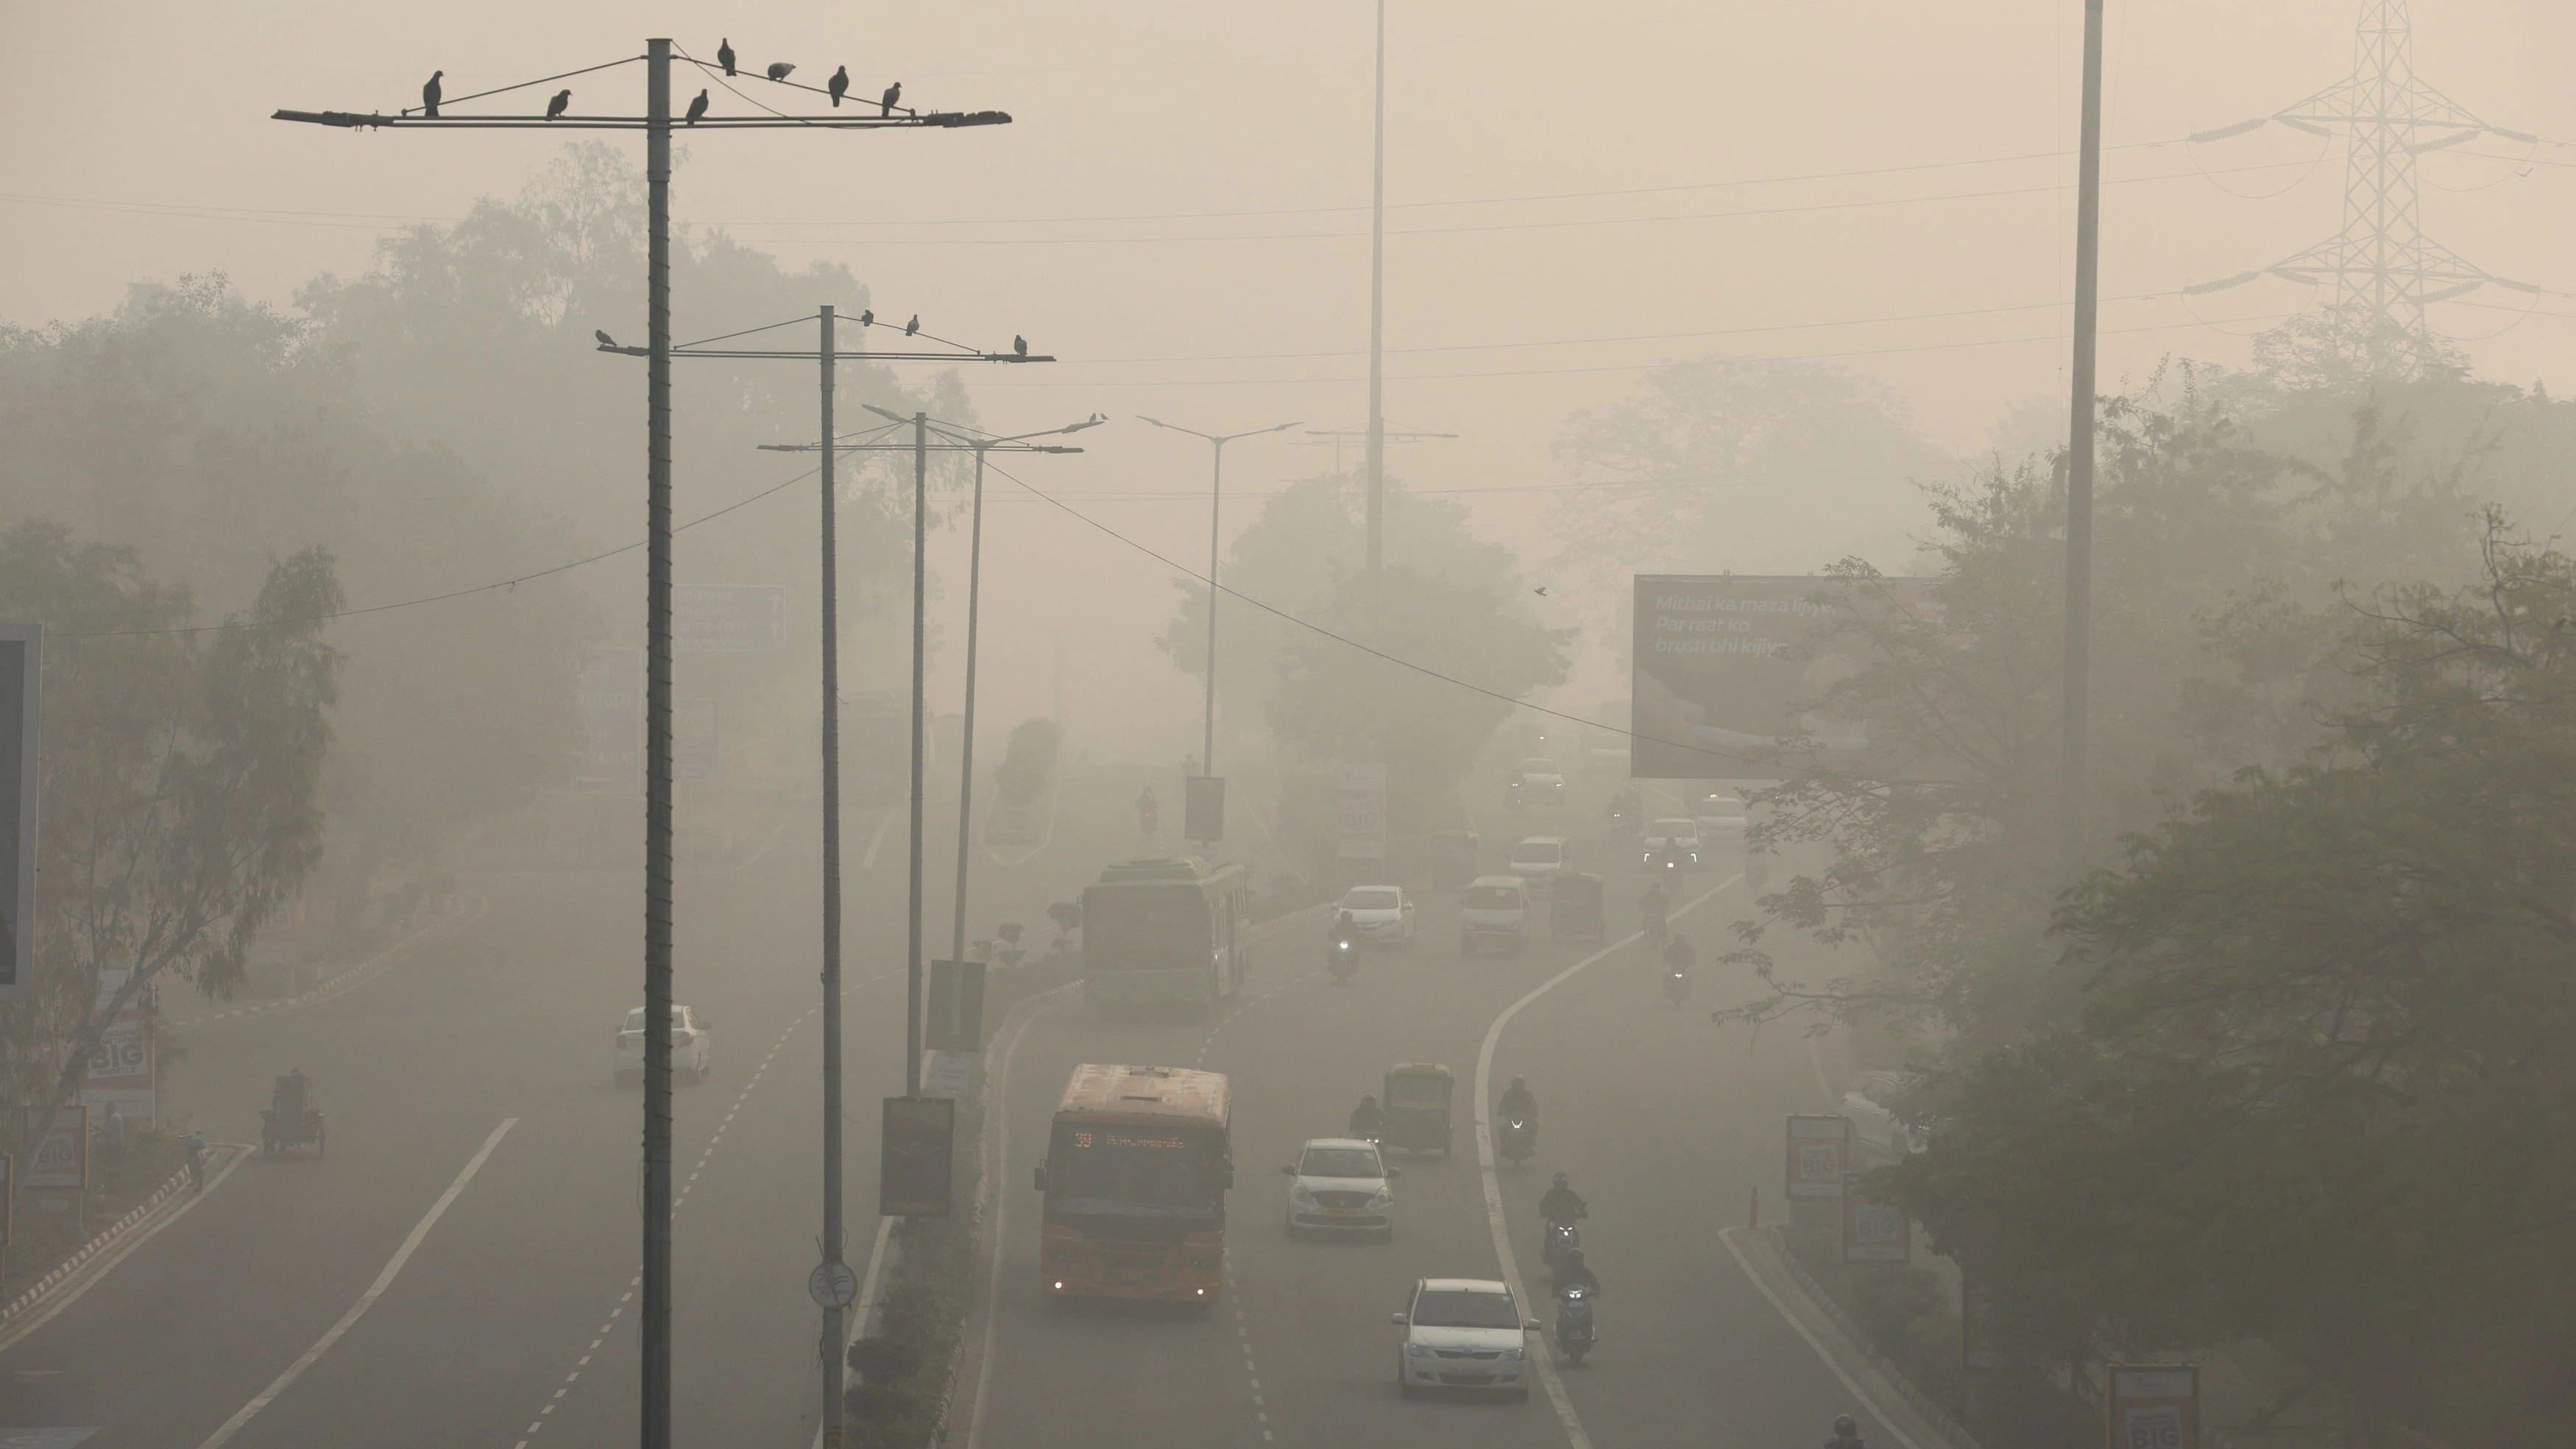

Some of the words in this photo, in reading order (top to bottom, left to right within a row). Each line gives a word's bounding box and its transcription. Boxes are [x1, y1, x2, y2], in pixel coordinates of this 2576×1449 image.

[1655, 595, 1713, 612] Mithai
[1714, 596, 1736, 612] ka
[1739, 600, 1788, 612] maza
[1655, 617, 1685, 631] Par
[1688, 618, 1725, 632] raat
[1727, 618, 1750, 632] ko
[1655, 637, 1708, 653] brush
[1709, 637, 1738, 653] bhi
[90, 1043, 144, 1069] BIG
[1802, 1158, 1836, 1173] BIG
[2131, 1425, 2180, 1449] BIG
